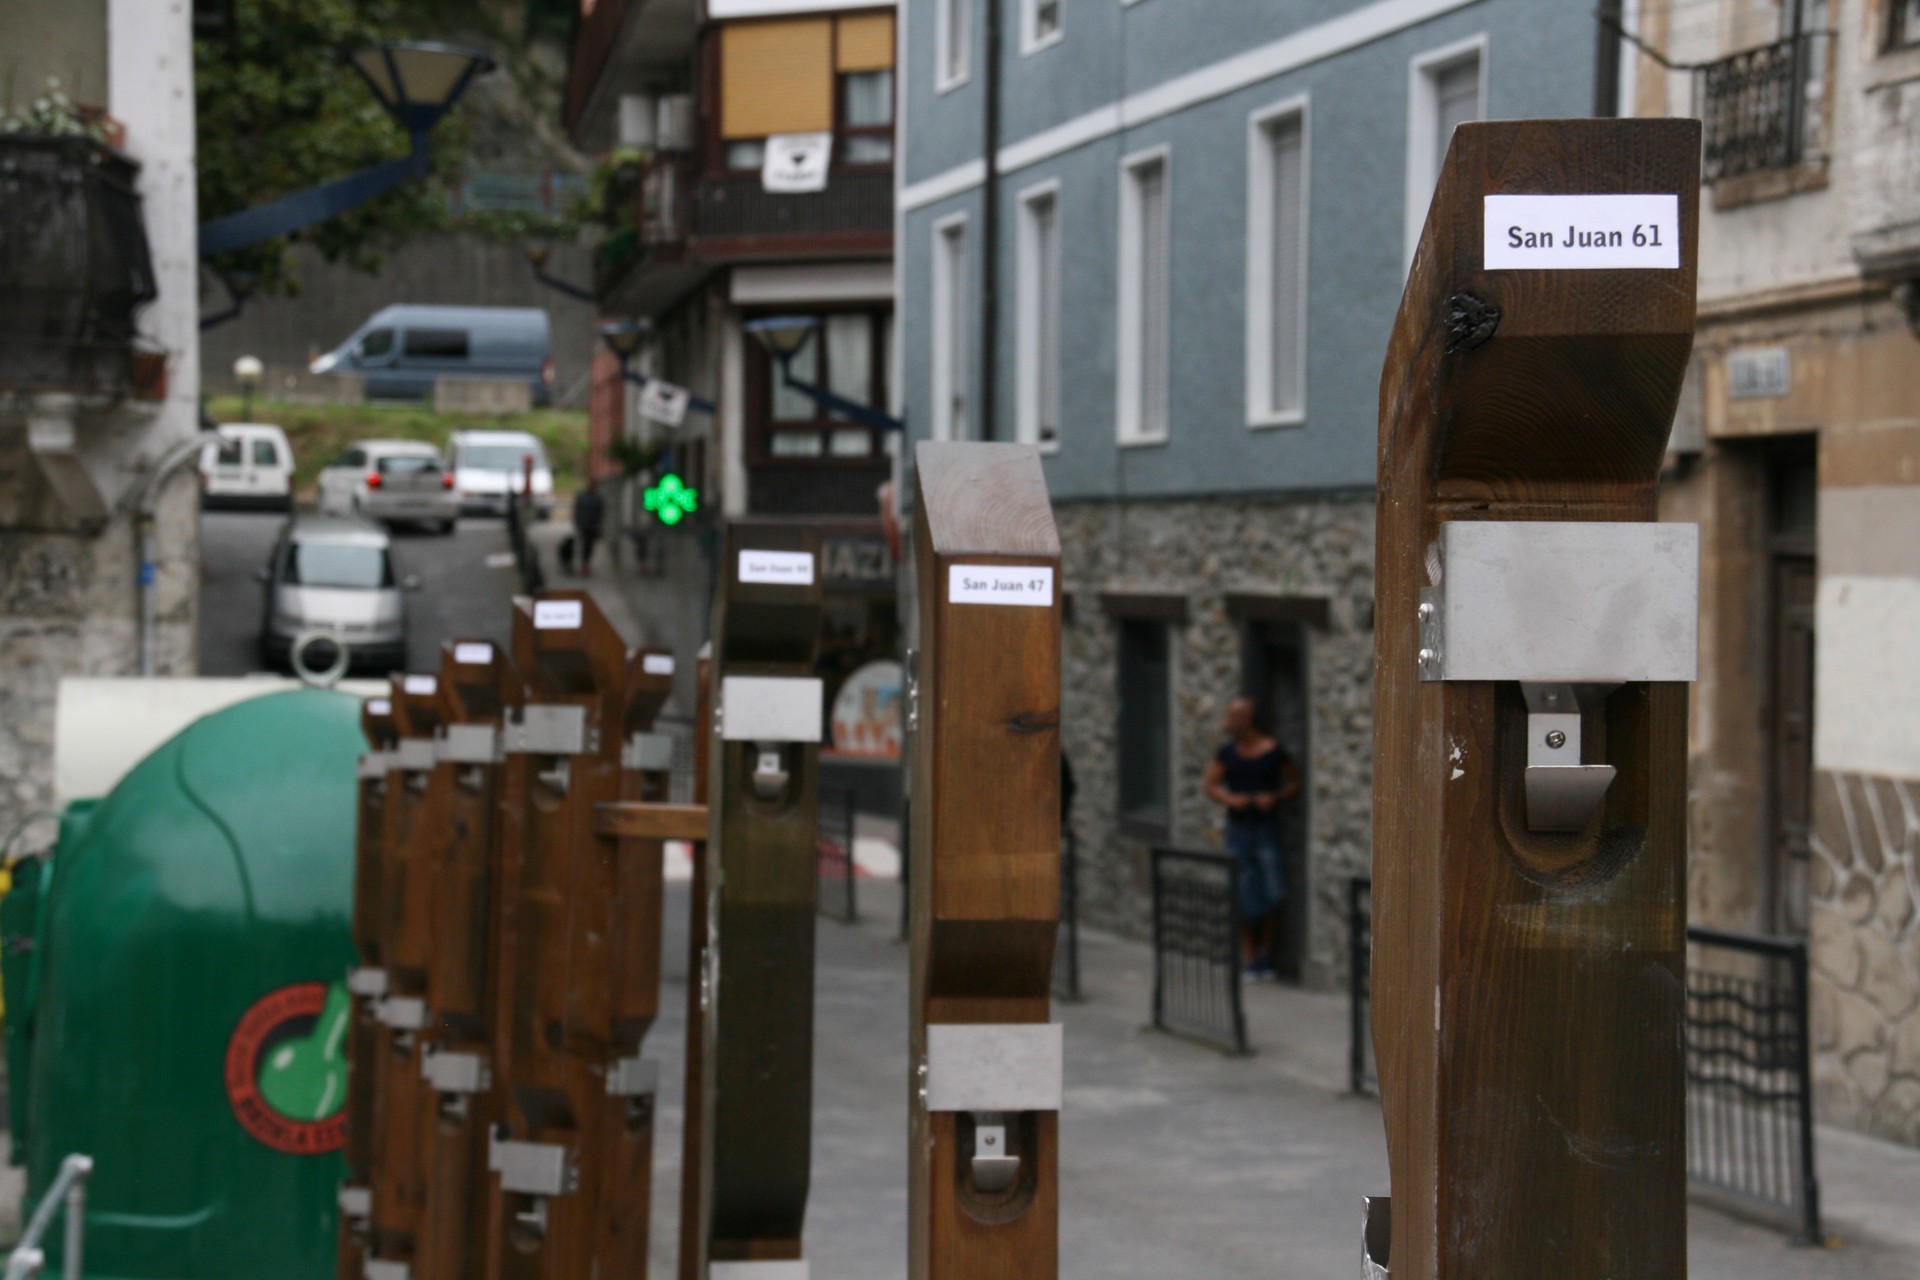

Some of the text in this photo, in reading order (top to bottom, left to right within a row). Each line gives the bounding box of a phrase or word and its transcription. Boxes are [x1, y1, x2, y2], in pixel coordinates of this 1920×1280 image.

[1507, 224, 1663, 249] San Juan 61
[962, 578, 1045, 592] San Juan 47
